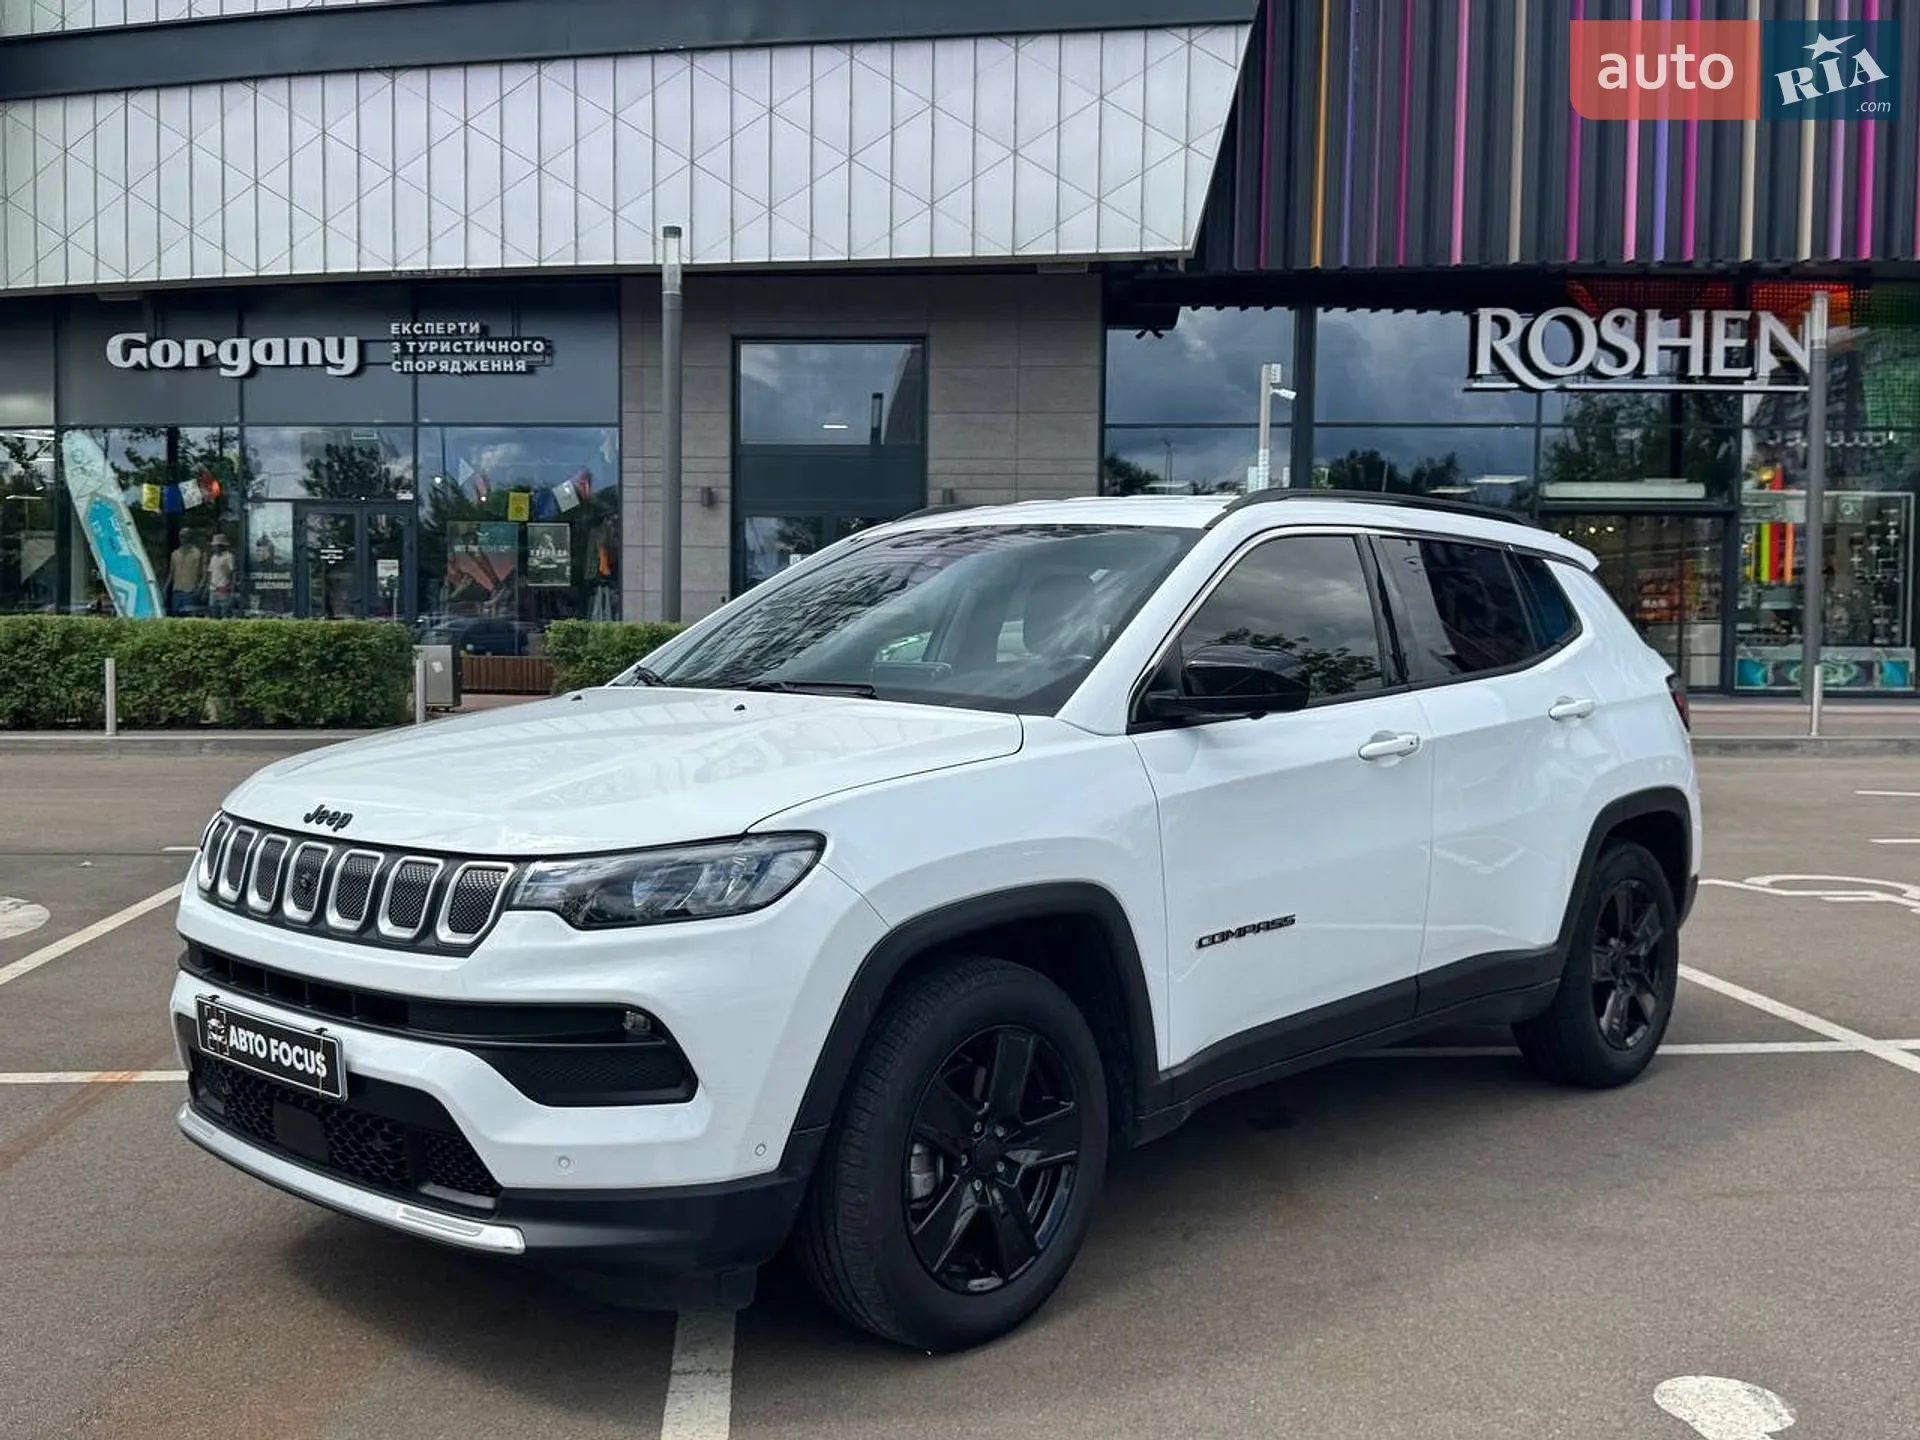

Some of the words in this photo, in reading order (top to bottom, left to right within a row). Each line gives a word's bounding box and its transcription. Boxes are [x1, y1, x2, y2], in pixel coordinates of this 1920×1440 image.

[390, 322, 480, 335] ЕКСПЕРТИ
[106, 332, 359, 377] Gorgany
[391, 341, 401, 353] З
[406, 340, 545, 353] ТУРИСТИЧНОГО
[1474, 306, 1811, 390] ROSHEN
[391, 360, 527, 373] СПОРЯДЖЕННЯ
[303, 804, 353, 832] Jeep
[1195, 913, 1296, 949] COMPASS
[229, 1025, 267, 1059] АВТО
[269, 1038, 327, 1078] FOCUS
